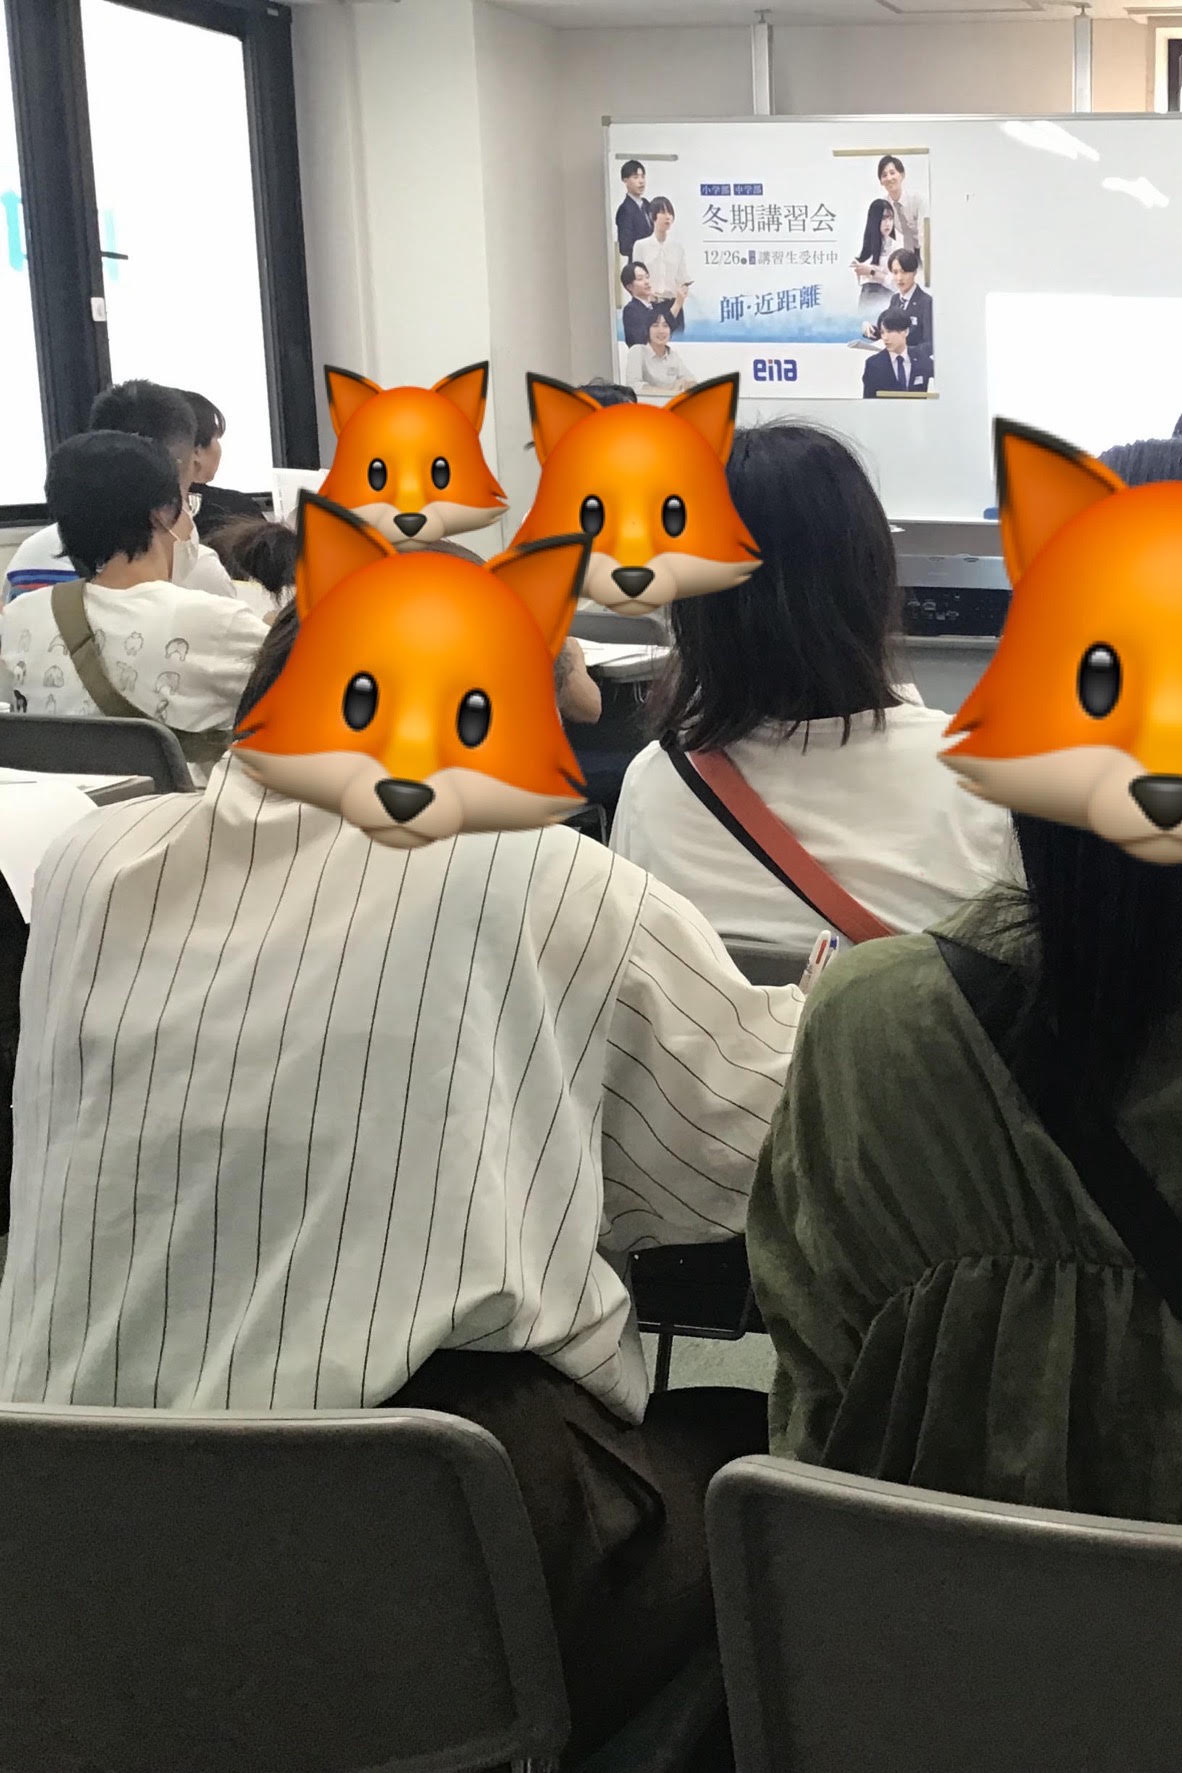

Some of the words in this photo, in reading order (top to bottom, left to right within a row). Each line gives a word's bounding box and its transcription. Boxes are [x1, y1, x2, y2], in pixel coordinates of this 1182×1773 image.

[702, 203, 837, 232] 冬期講習会
[758, 249, 839, 265] 講習生受付中
[753, 359, 798, 382] ena
